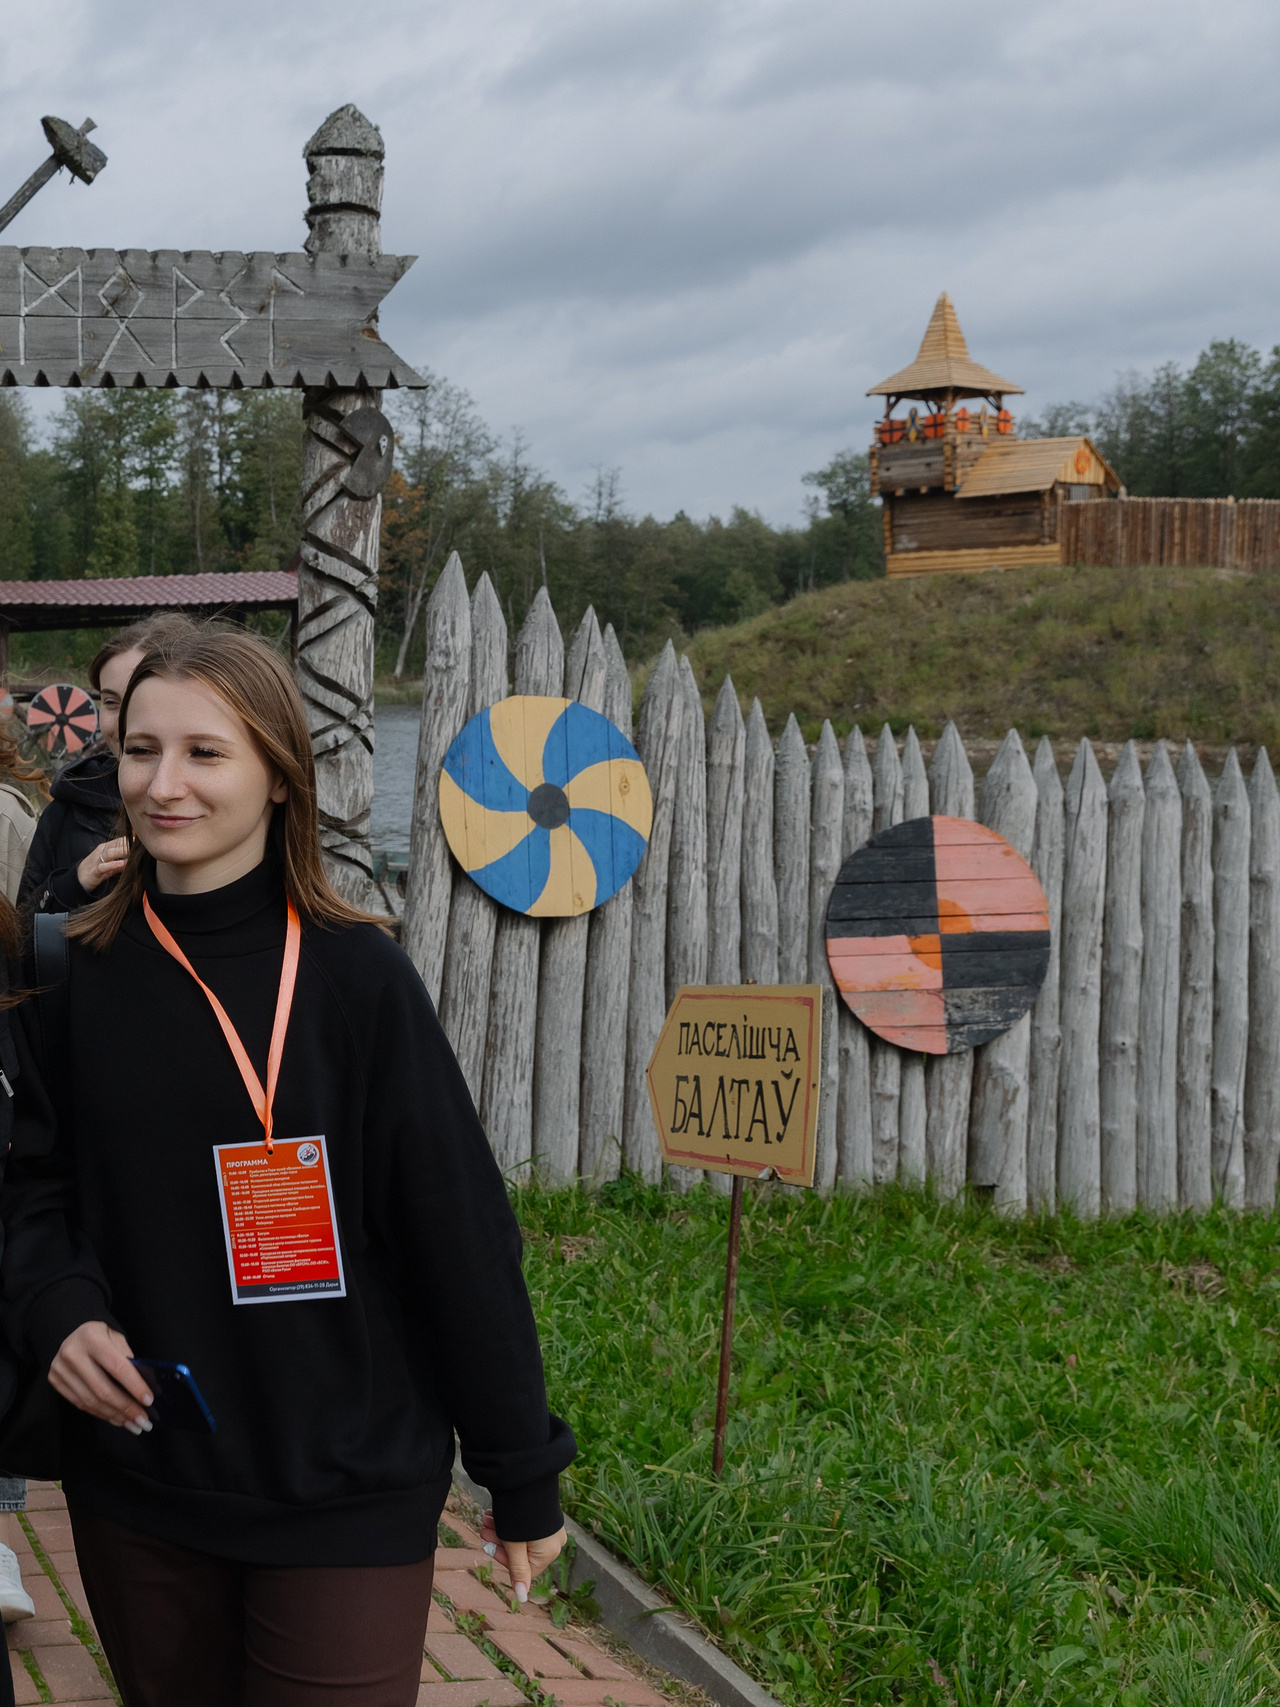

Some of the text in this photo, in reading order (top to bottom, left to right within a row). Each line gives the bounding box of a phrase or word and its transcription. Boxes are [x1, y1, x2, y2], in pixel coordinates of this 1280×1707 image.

[678, 1014, 801, 1062] ПАСЕЛІШЧА
[670, 1068, 801, 1144] БАЛТАЎ
[226, 1158, 268, 1168] ПРОГРАММА
